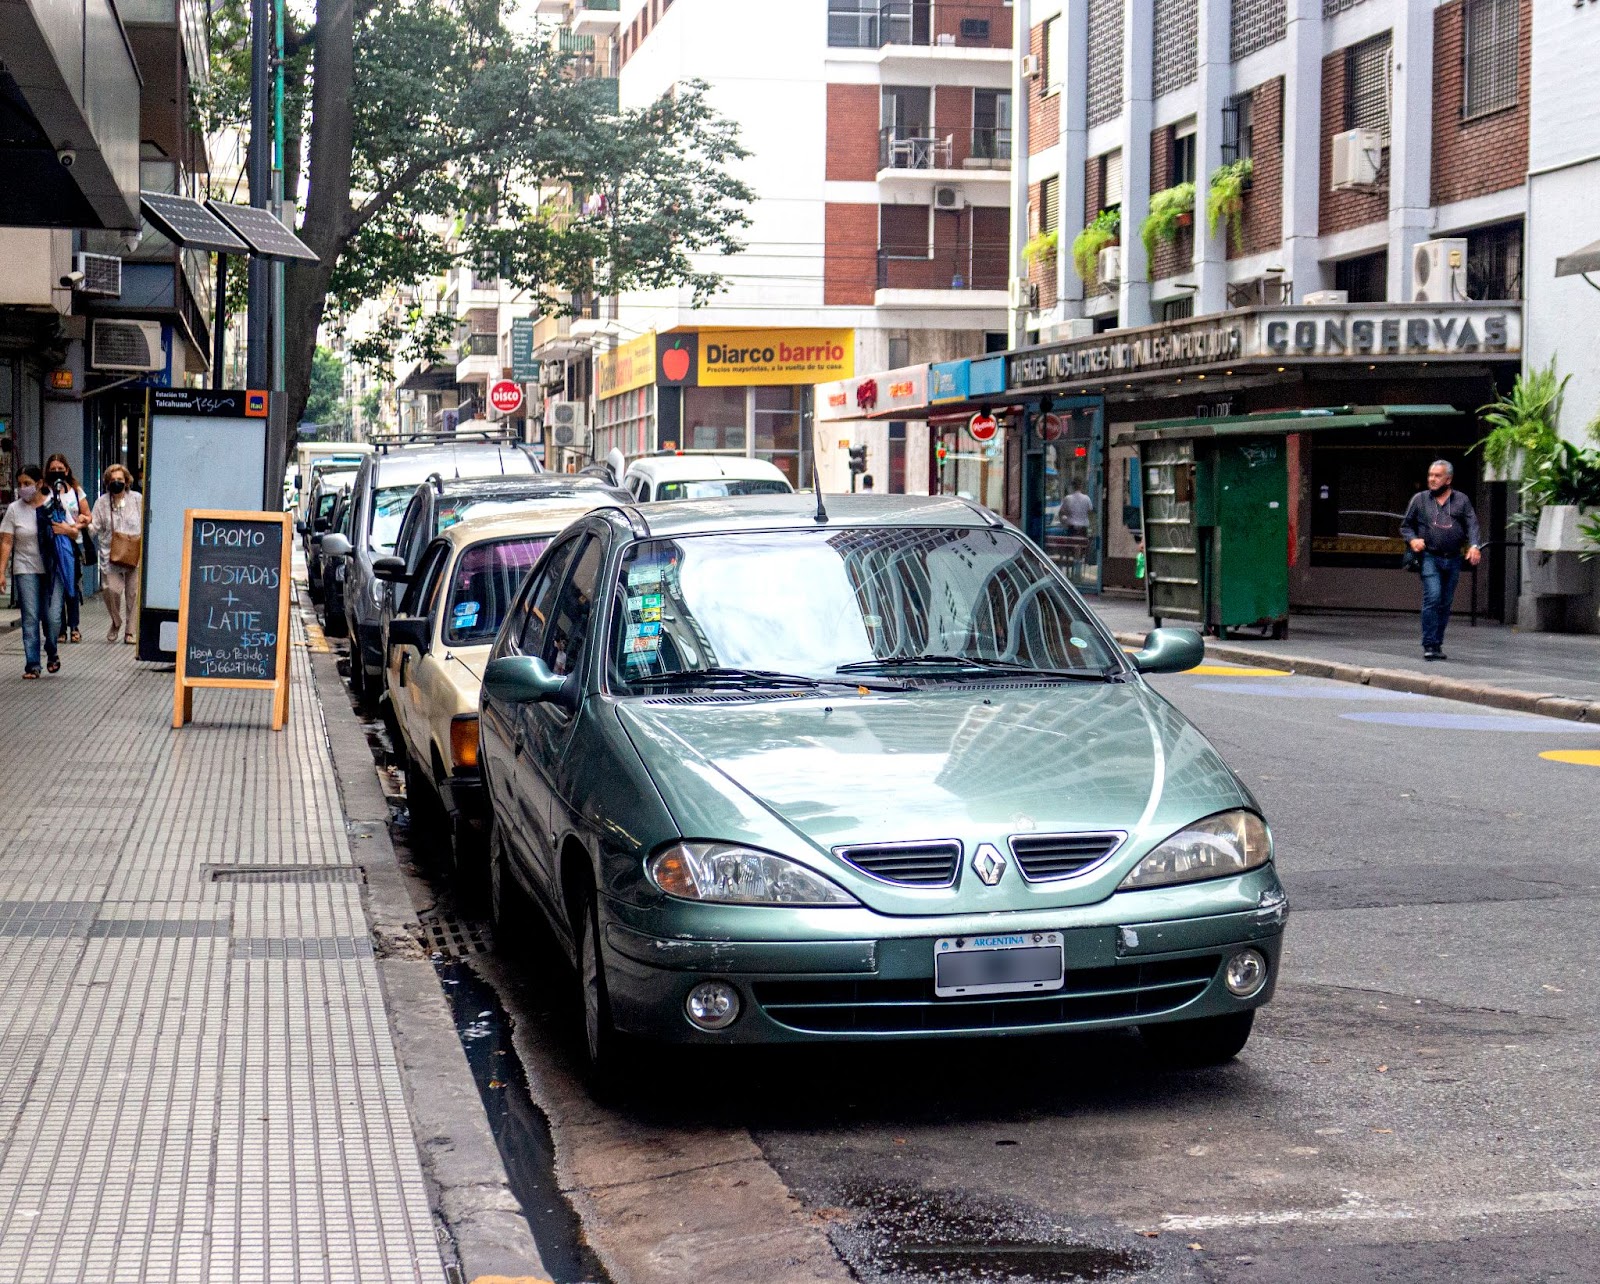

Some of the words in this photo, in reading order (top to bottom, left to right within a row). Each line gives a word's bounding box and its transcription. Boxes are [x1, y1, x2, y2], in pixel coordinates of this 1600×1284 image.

[1267, 314, 1509, 353] CONSERVAS
[706, 343, 775, 364] Diarco
[779, 341, 845, 362] barrio
[155, 399, 192, 409] Talcahuano
[200, 521, 265, 548] PROMO
[199, 564, 279, 589] TOSTADAS
[220, 590, 240, 607] +
[207, 605, 262, 633] LATTE
[973, 935, 1025, 947] ARGENTINA
